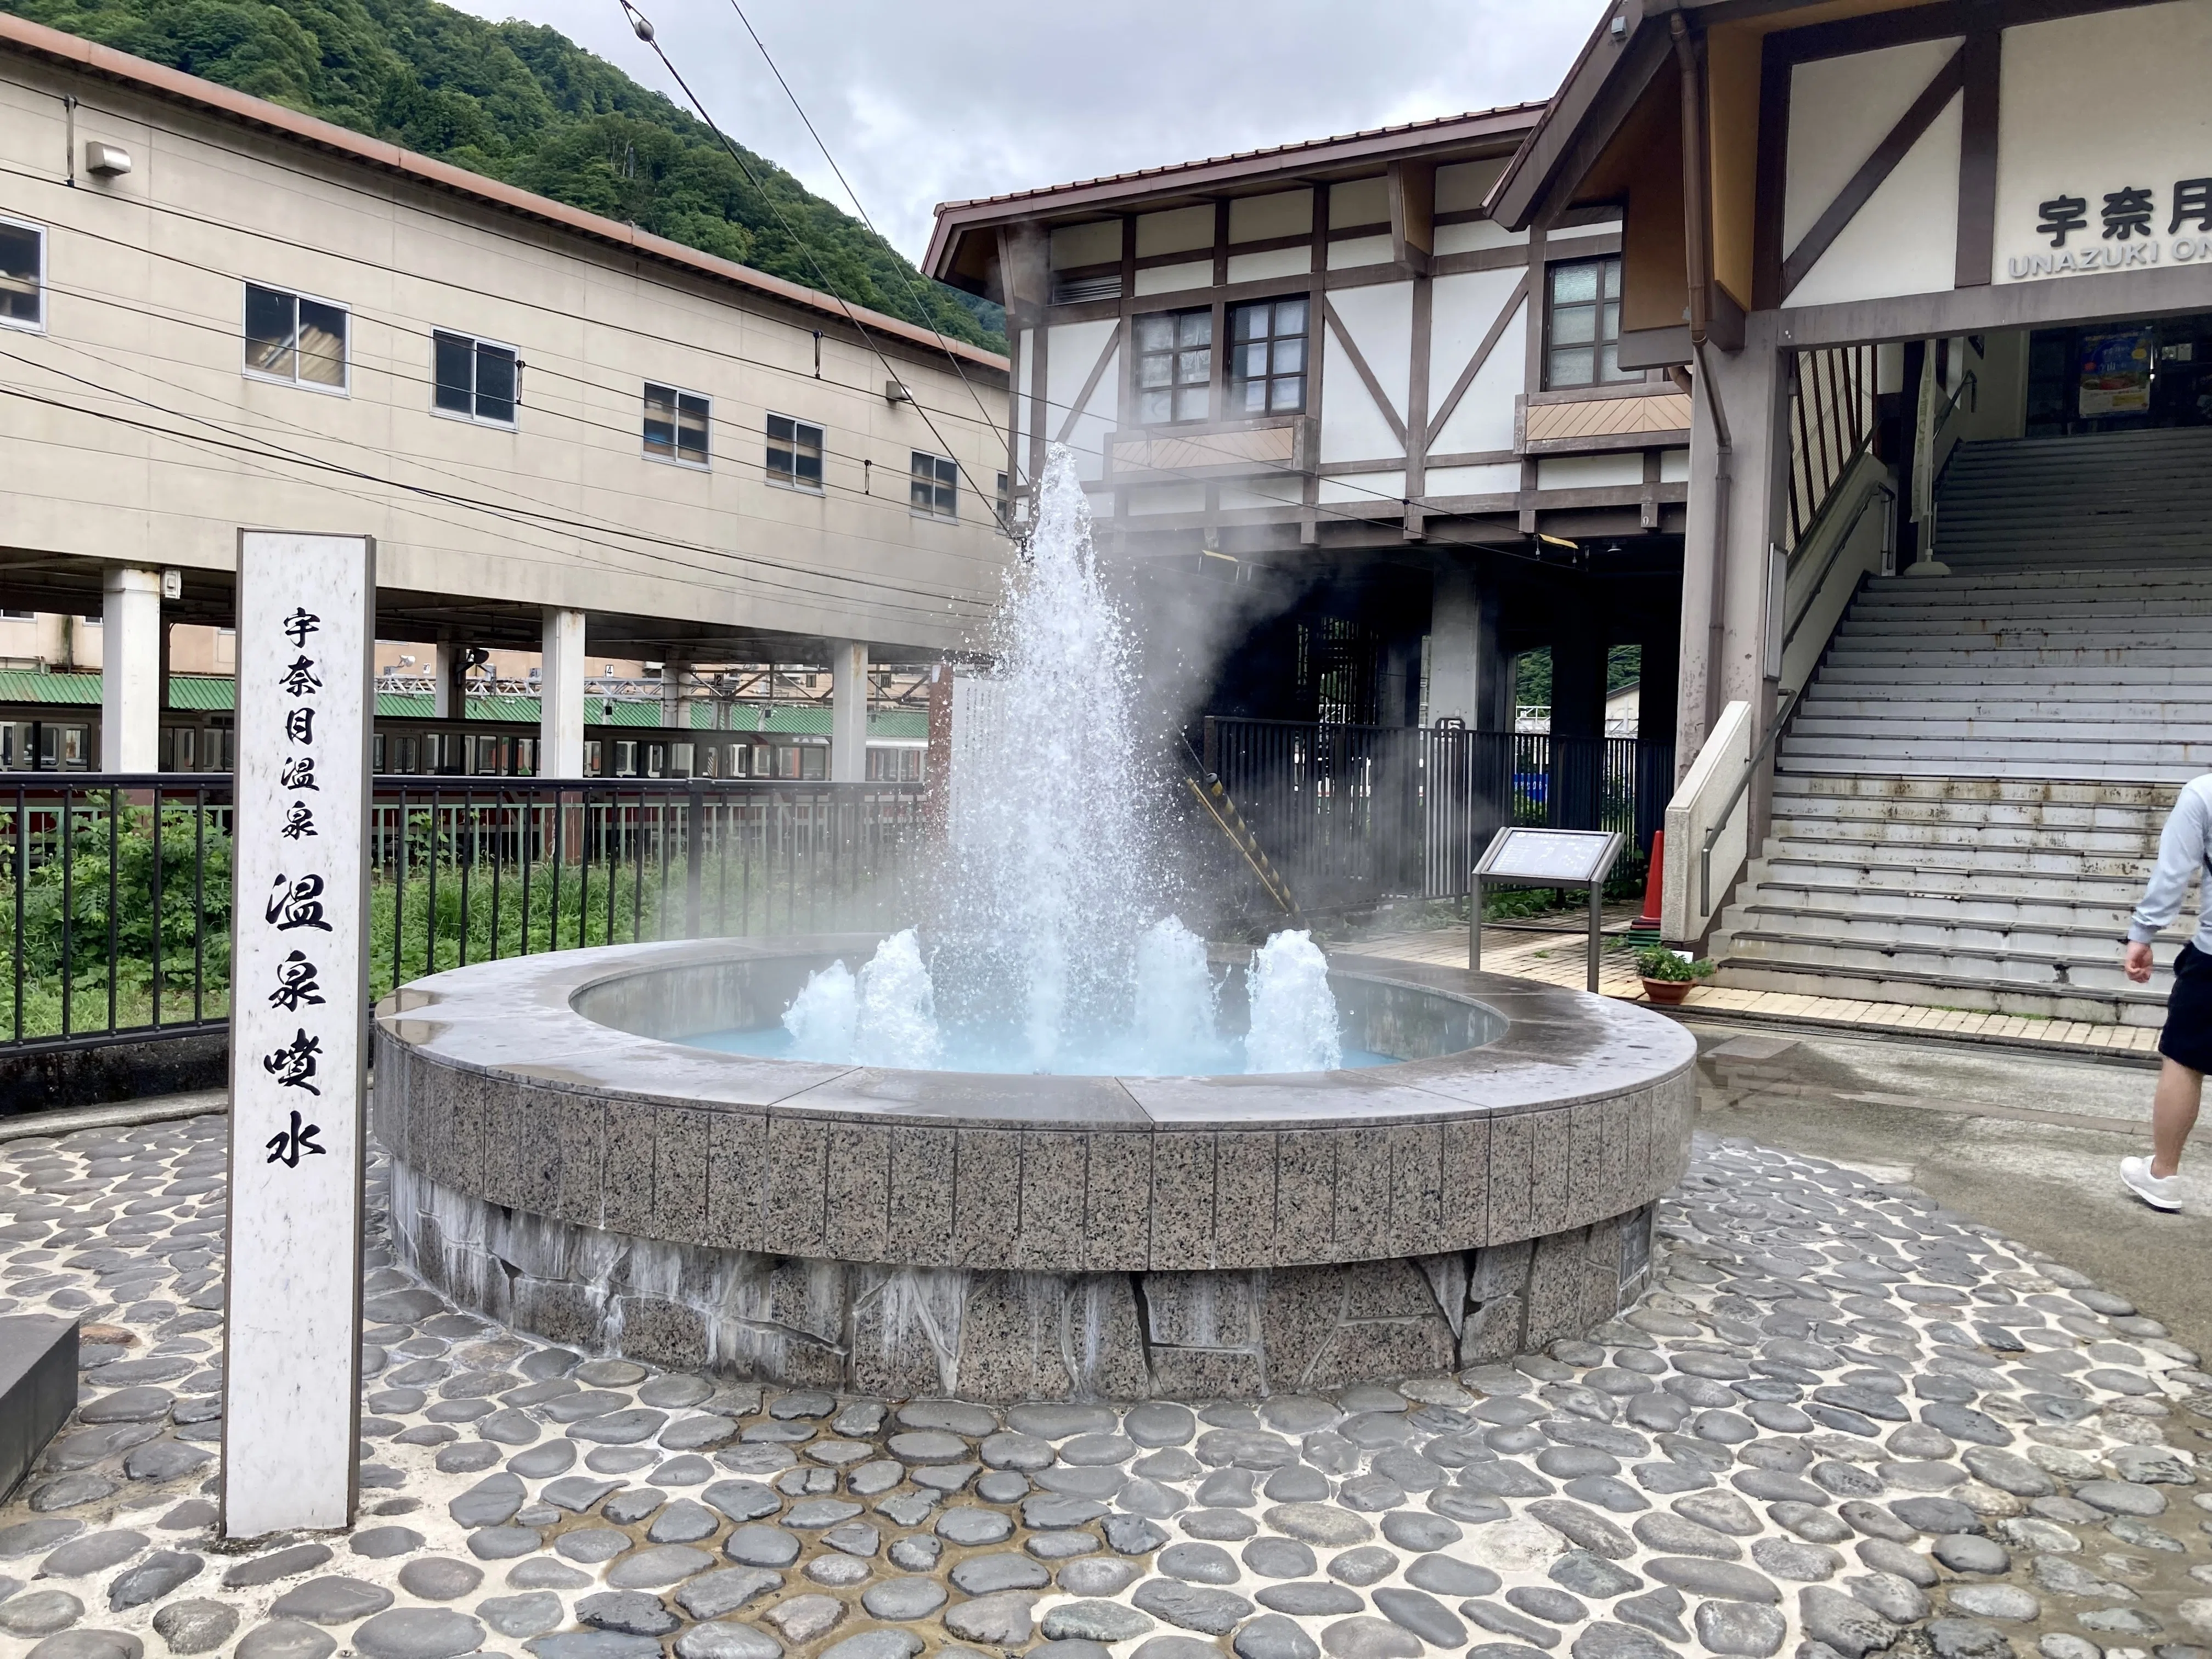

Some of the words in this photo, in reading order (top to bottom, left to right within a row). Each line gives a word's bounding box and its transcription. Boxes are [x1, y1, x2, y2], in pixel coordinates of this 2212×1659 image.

[2036, 177, 2212, 247] 宇奈月
[2008, 241, 2159, 278] UNAZUKI
[607, 666, 613, 675] 4
[716, 675, 722, 686] 2
[279, 607, 323, 840] 宇奈月温泉
[1441, 720, 1460, 737] 15
[263, 873, 334, 1169] 温泉噴水
